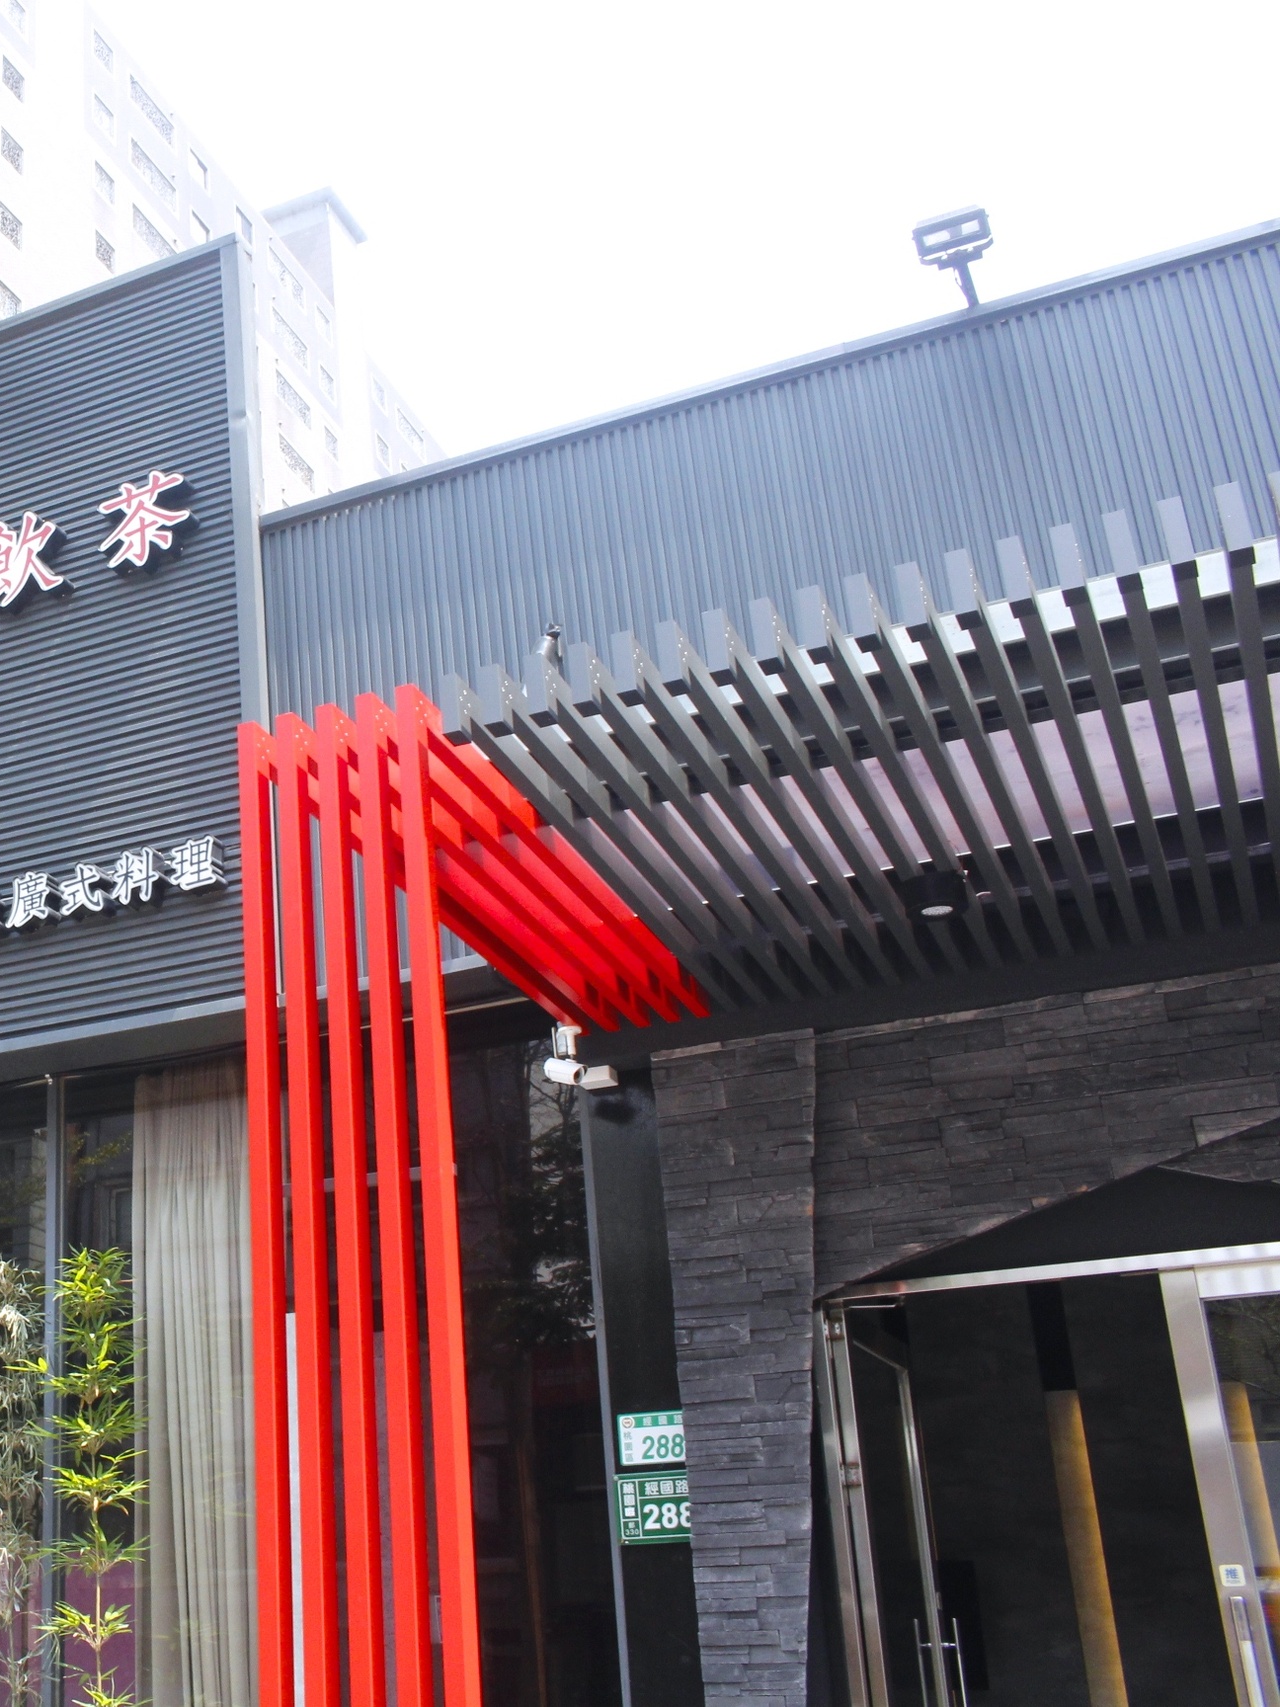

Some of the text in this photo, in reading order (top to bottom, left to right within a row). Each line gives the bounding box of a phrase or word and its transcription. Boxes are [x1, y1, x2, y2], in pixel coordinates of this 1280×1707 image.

[641, 1433, 684, 1460] 288
[643, 1502, 691, 1530] 288
[625, 1528, 639, 1536] 330
[1224, 1567, 1239, 1579] 推
